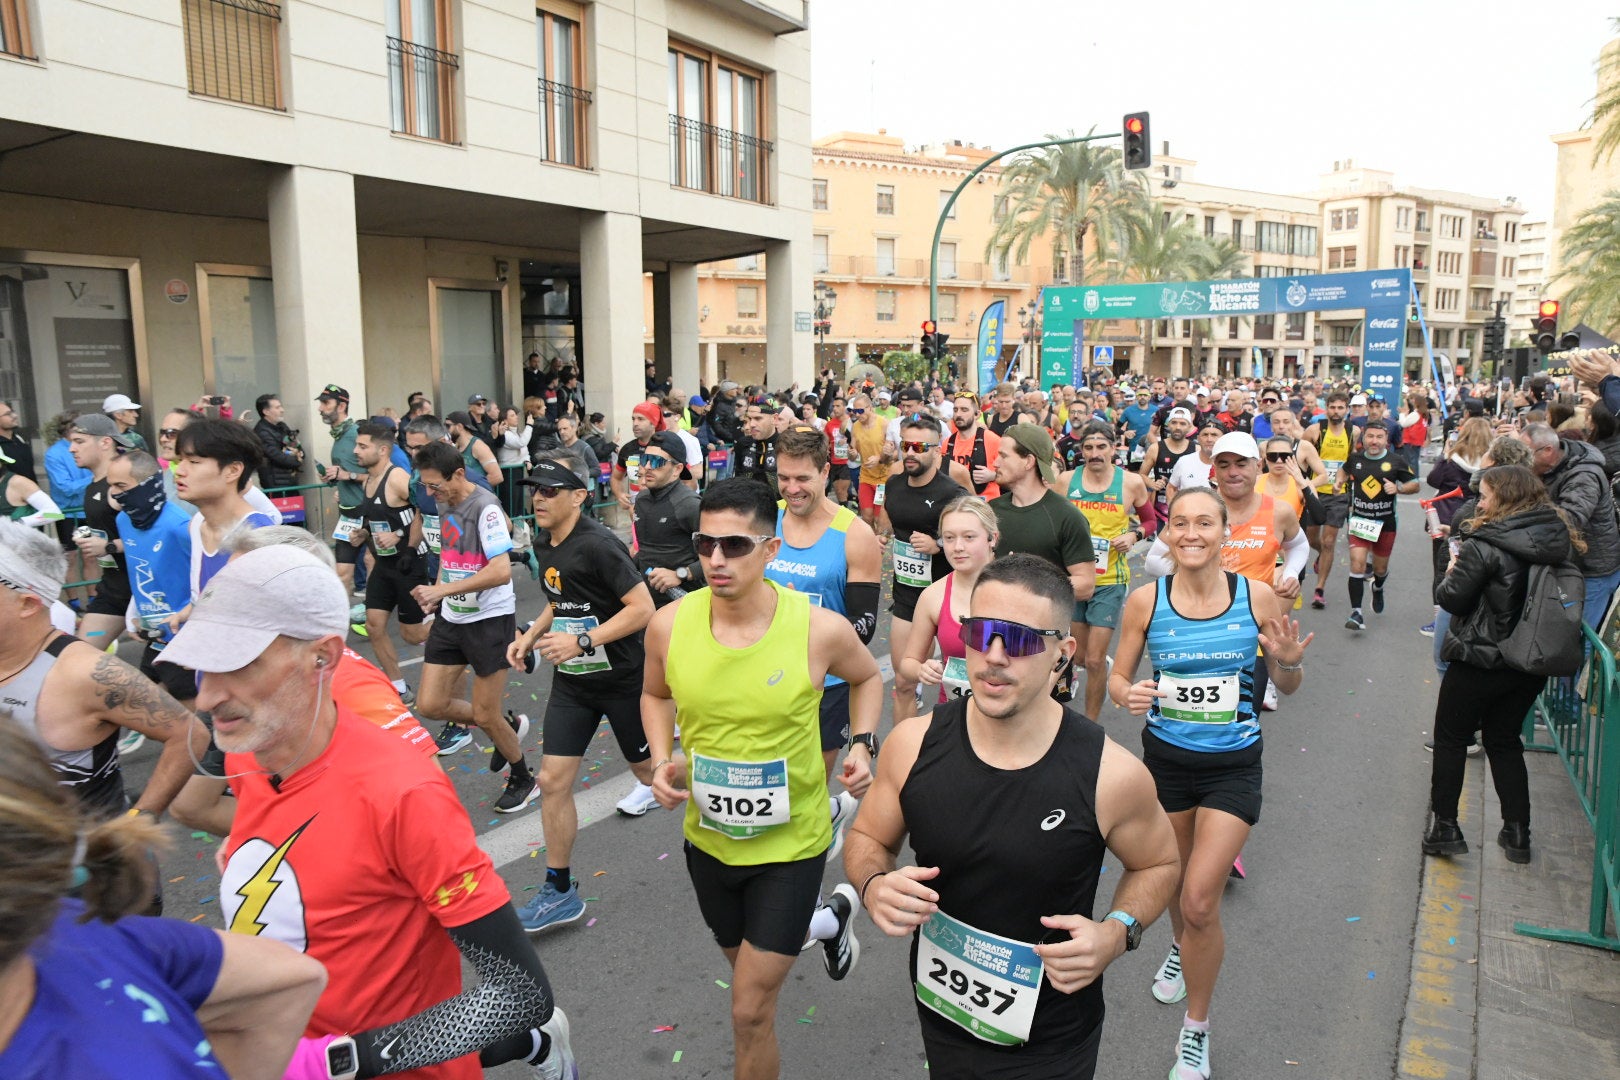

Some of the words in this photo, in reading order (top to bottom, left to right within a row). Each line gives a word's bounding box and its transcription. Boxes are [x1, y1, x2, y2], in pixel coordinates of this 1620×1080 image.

[1209, 293, 1241, 302] Elche
[1209, 301, 1260, 311] Alicante
[1354, 497, 1392, 510] Ginestar
[896, 560, 925, 575] 3563
[1179, 652, 1244, 660] PUBLIDOM
[1176, 685, 1221, 704] 393
[708, 793, 773, 817] 3102
[963, 943, 993, 961] Elche
[992, 955, 1010, 968] 42K
[975, 939, 1013, 957] MARATÓN
[962, 951, 1008, 975] Alicante
[928, 957, 1016, 1016] 2937
